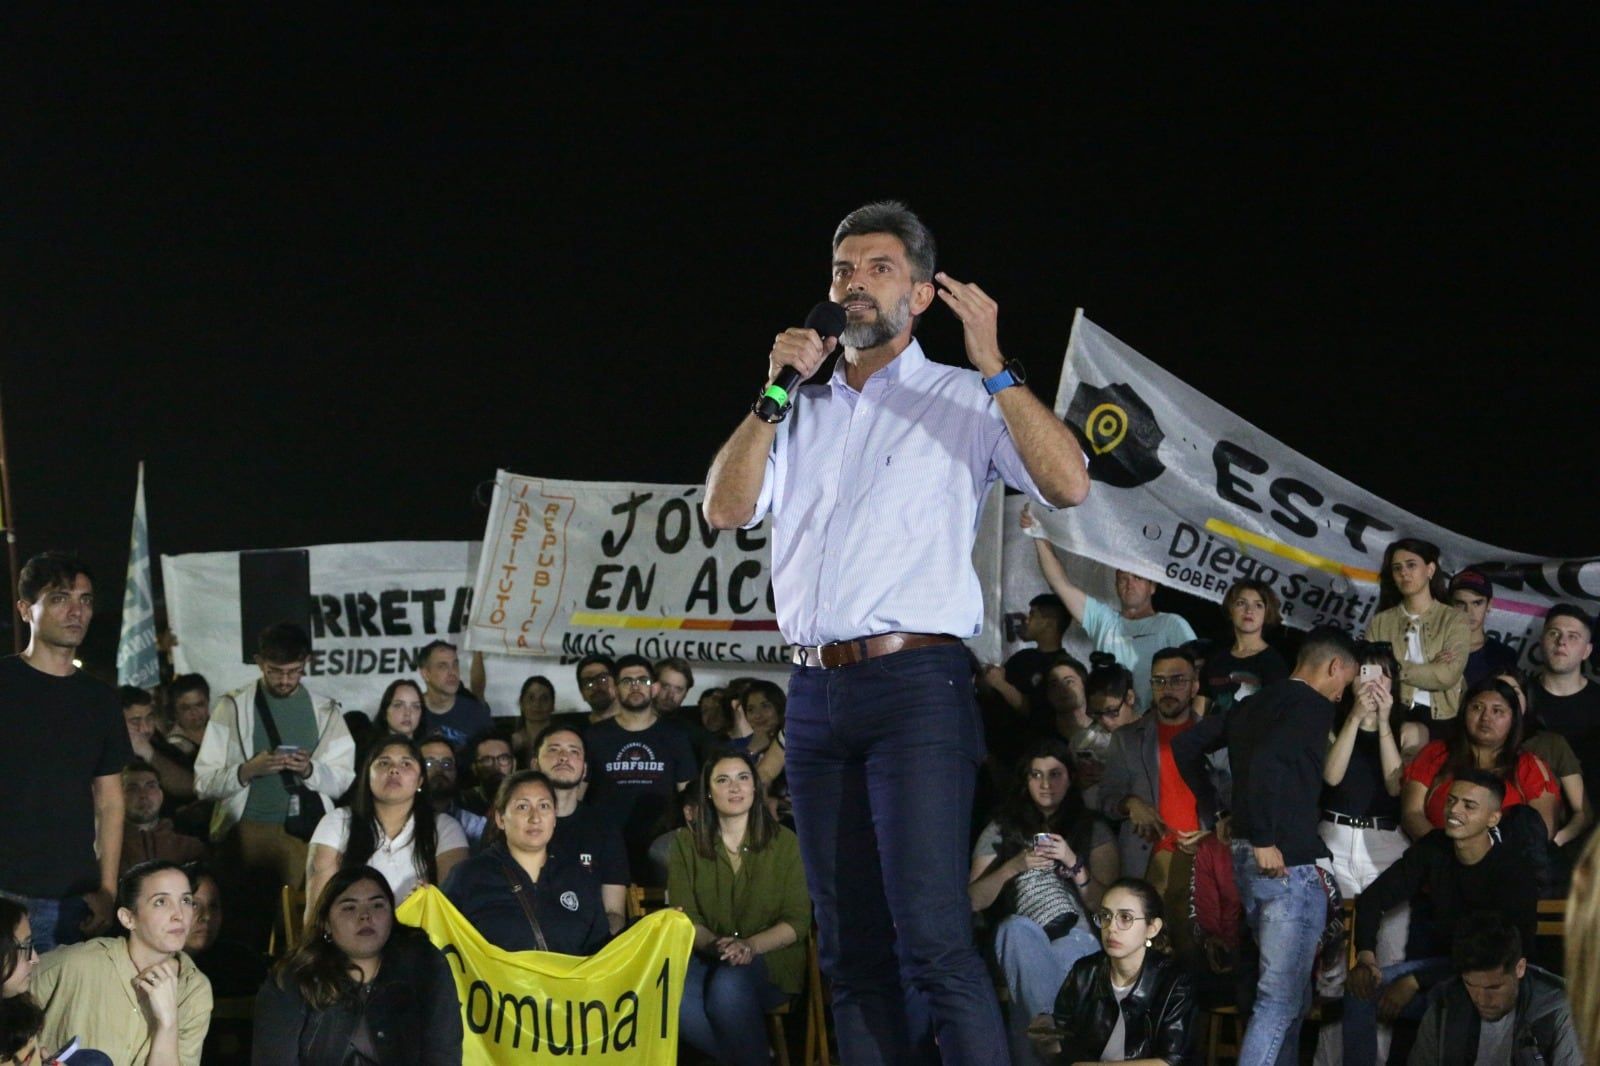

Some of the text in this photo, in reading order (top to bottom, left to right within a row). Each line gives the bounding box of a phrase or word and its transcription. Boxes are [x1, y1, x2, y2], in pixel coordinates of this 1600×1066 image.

[601, 488, 767, 558] JÓVE
[490, 484, 530, 625] INSTITUTO
[517, 503, 560, 648] REPUBLICA
[1168, 522, 1377, 624] Diego Santi
[309, 587, 474, 639] RRETA
[585, 562, 656, 612] EN
[1165, 562, 1295, 617] GOBERR
[308, 647, 420, 677] ESIDEN
[561, 629, 615, 658] MÁS
[605, 761, 665, 772] SURFSIDE
[656, 957, 670, 1039] 1
